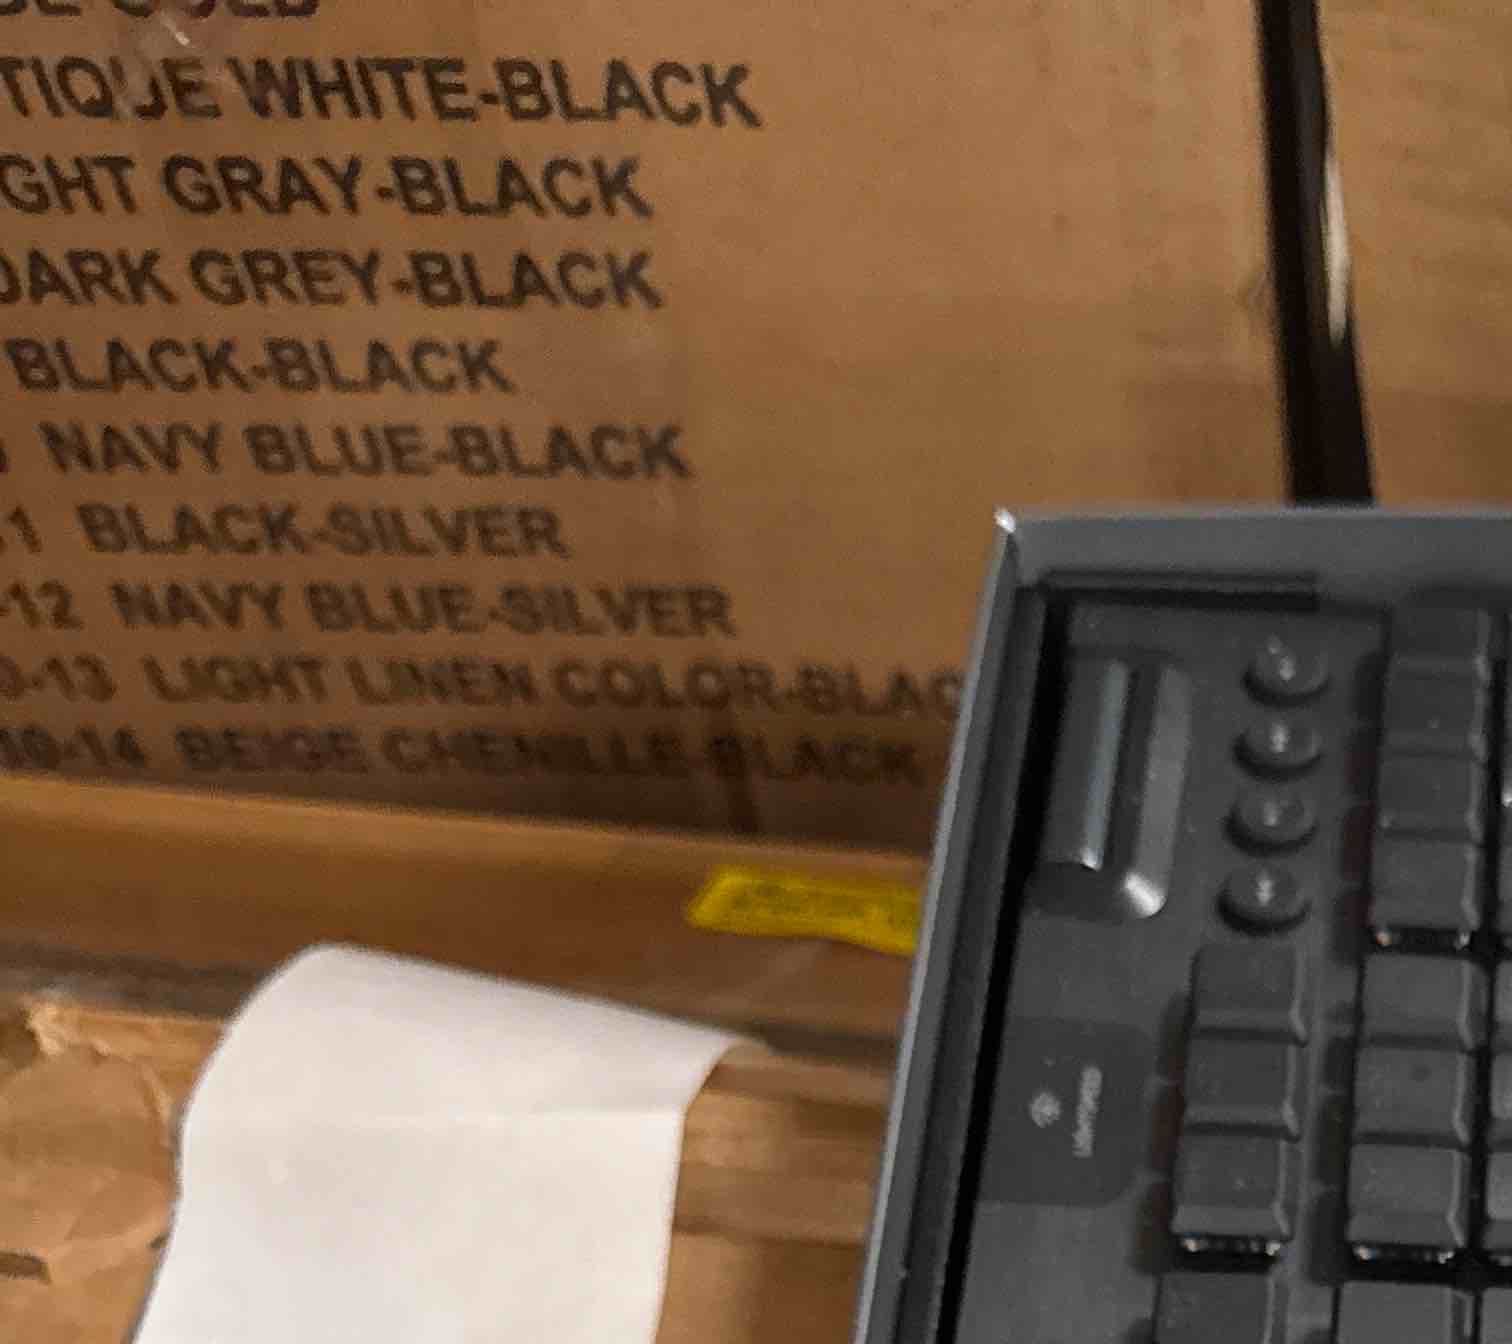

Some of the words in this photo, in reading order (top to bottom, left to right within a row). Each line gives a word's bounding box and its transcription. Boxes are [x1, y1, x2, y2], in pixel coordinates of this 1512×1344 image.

[225, 57, 763, 128] WHITE-BLACK
[162, 154, 653, 219] GRAY-BLACK
[190, 249, 664, 310] GREY-BLACK
[4, 337, 517, 396] BLACK-BLACK
[38, 420, 223, 475] NAVY
[244, 422, 694, 481] BLUE-BLACK
[75, 502, 571, 560] BLACK-SILVER
[111, 578, 283, 631] NAVY
[303, 580, 737, 639] BLUE-SILVER
[140, 654, 330, 704] LIGHT
